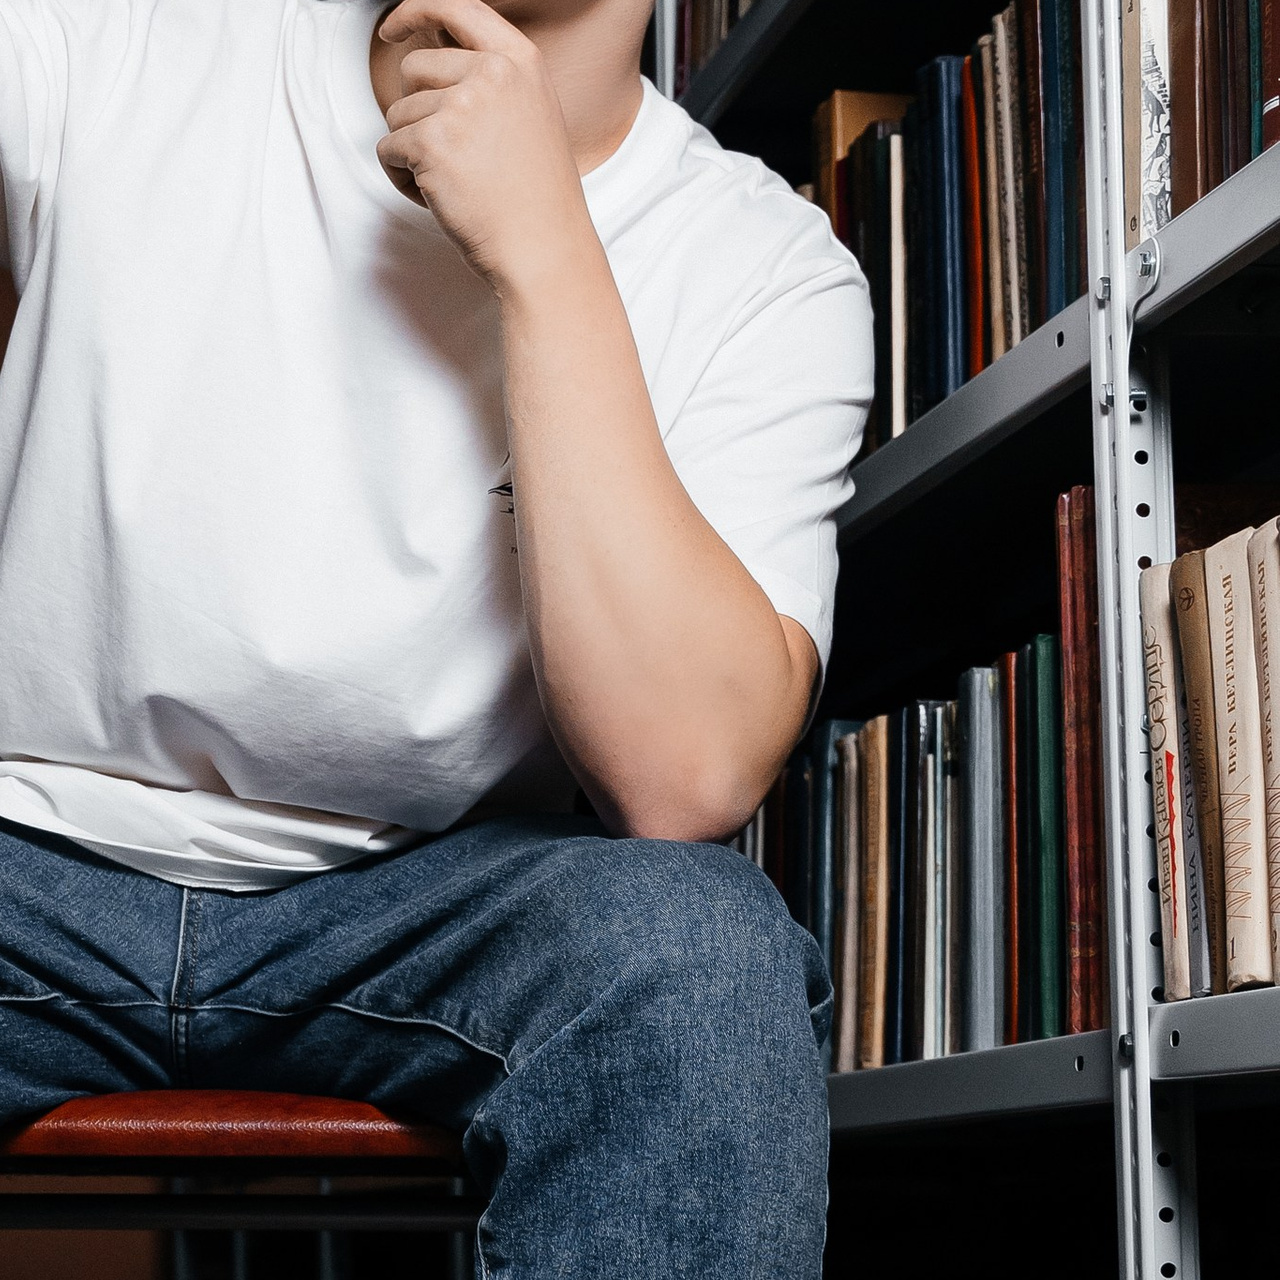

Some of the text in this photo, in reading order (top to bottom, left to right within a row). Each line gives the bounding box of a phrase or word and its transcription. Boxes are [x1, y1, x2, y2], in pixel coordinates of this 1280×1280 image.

[1221, 572, 1238, 776] ВЕРА КЕТЛИНСКАЯ
[1257, 558, 1273, 763] ВЕРА КЕТЛИНСКАЯ
[1161, 845, 1172, 908] Иван
[1181, 716, 1199, 935] НИНА КАТЕРЛИ
